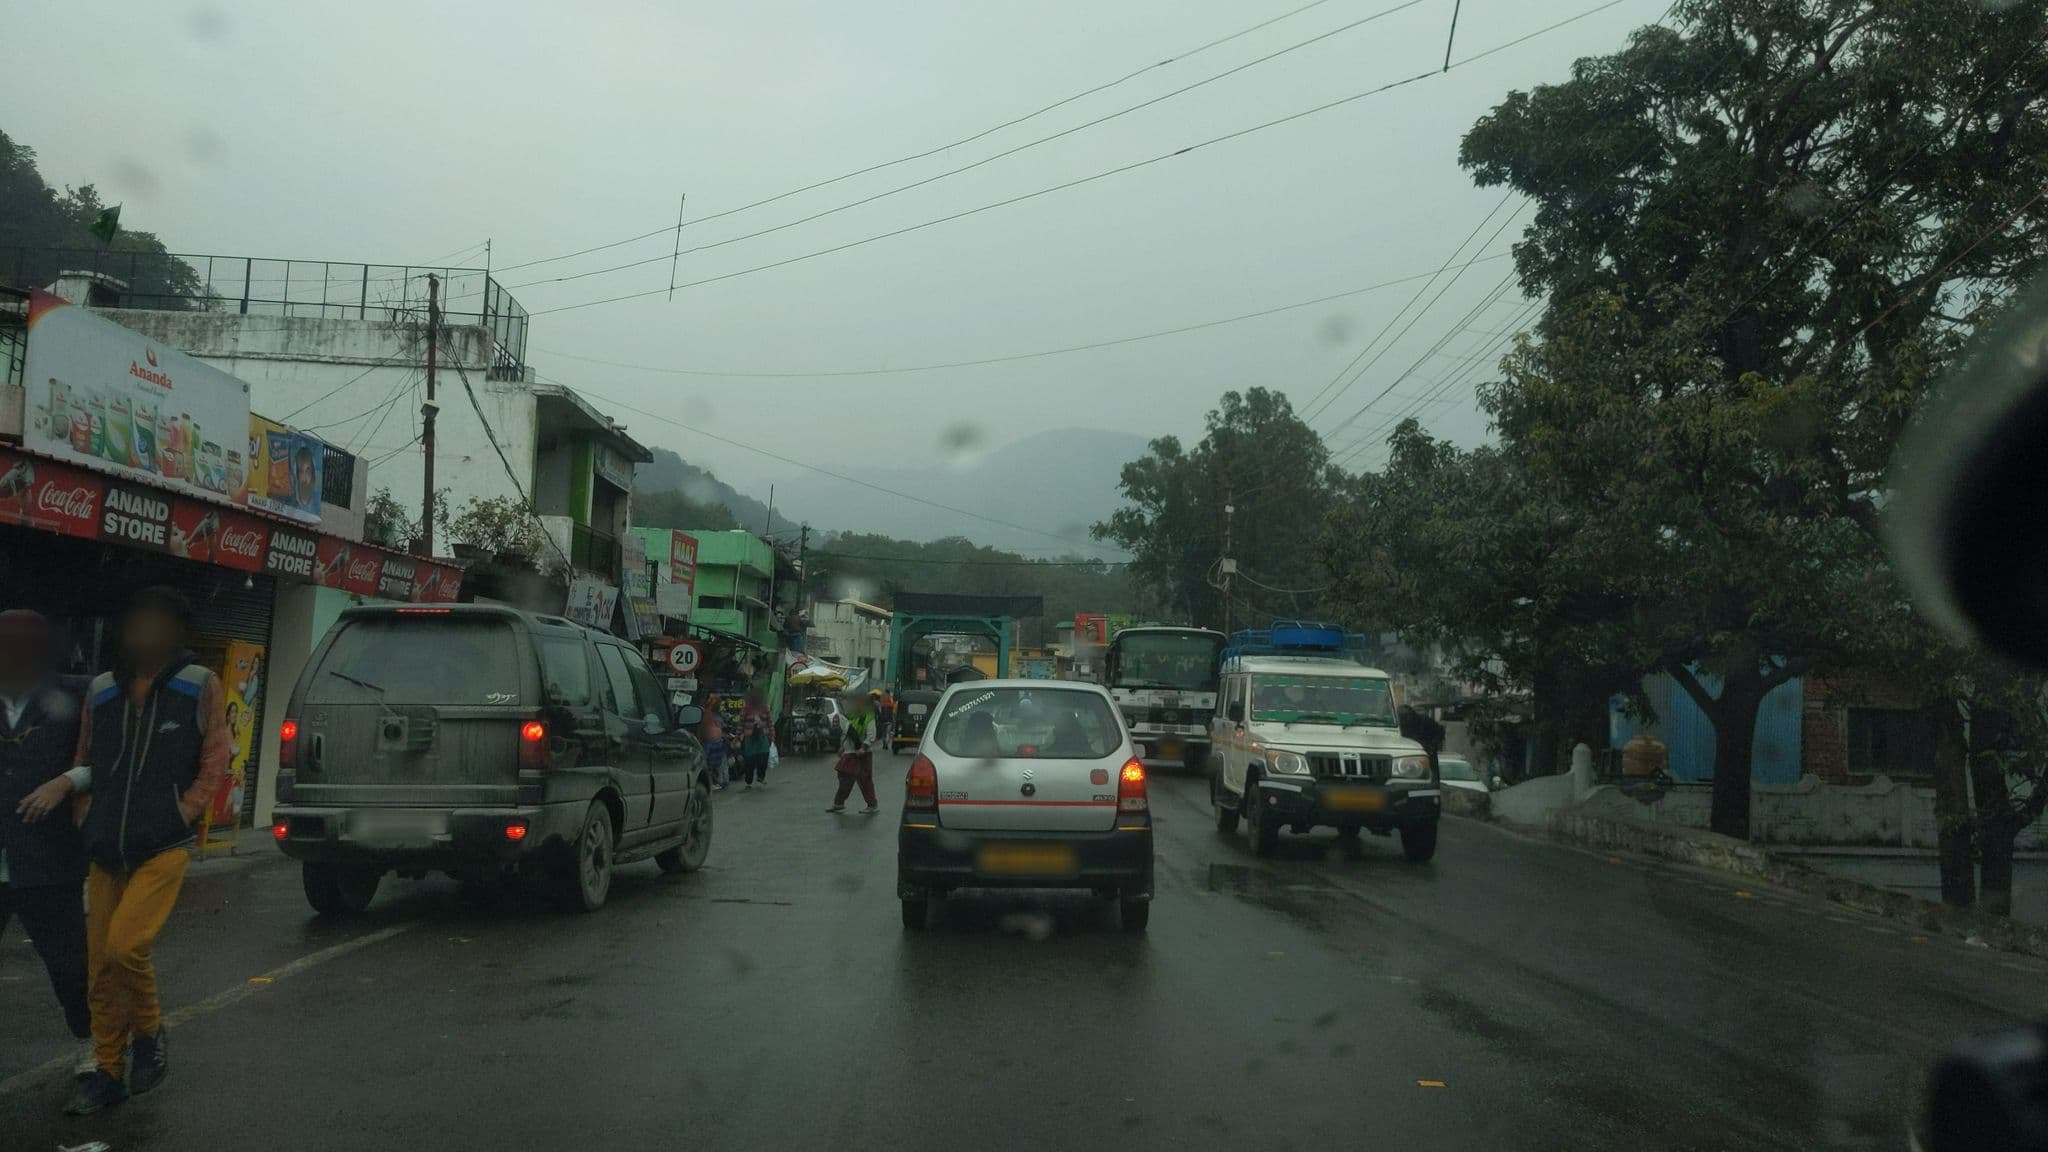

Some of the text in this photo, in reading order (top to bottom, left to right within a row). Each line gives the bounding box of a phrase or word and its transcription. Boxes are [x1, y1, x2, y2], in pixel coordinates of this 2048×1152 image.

[129, 360, 173, 389] Ananda
[105, 489, 169, 522] ANAND
[104, 513, 166, 544] STORE
[270, 532, 316, 557] ANAND
[267, 552, 313, 576] STORE
[381, 560, 415, 580] ANAND
[379, 577, 411, 596] STRE
[675, 651, 693, 664] 20
